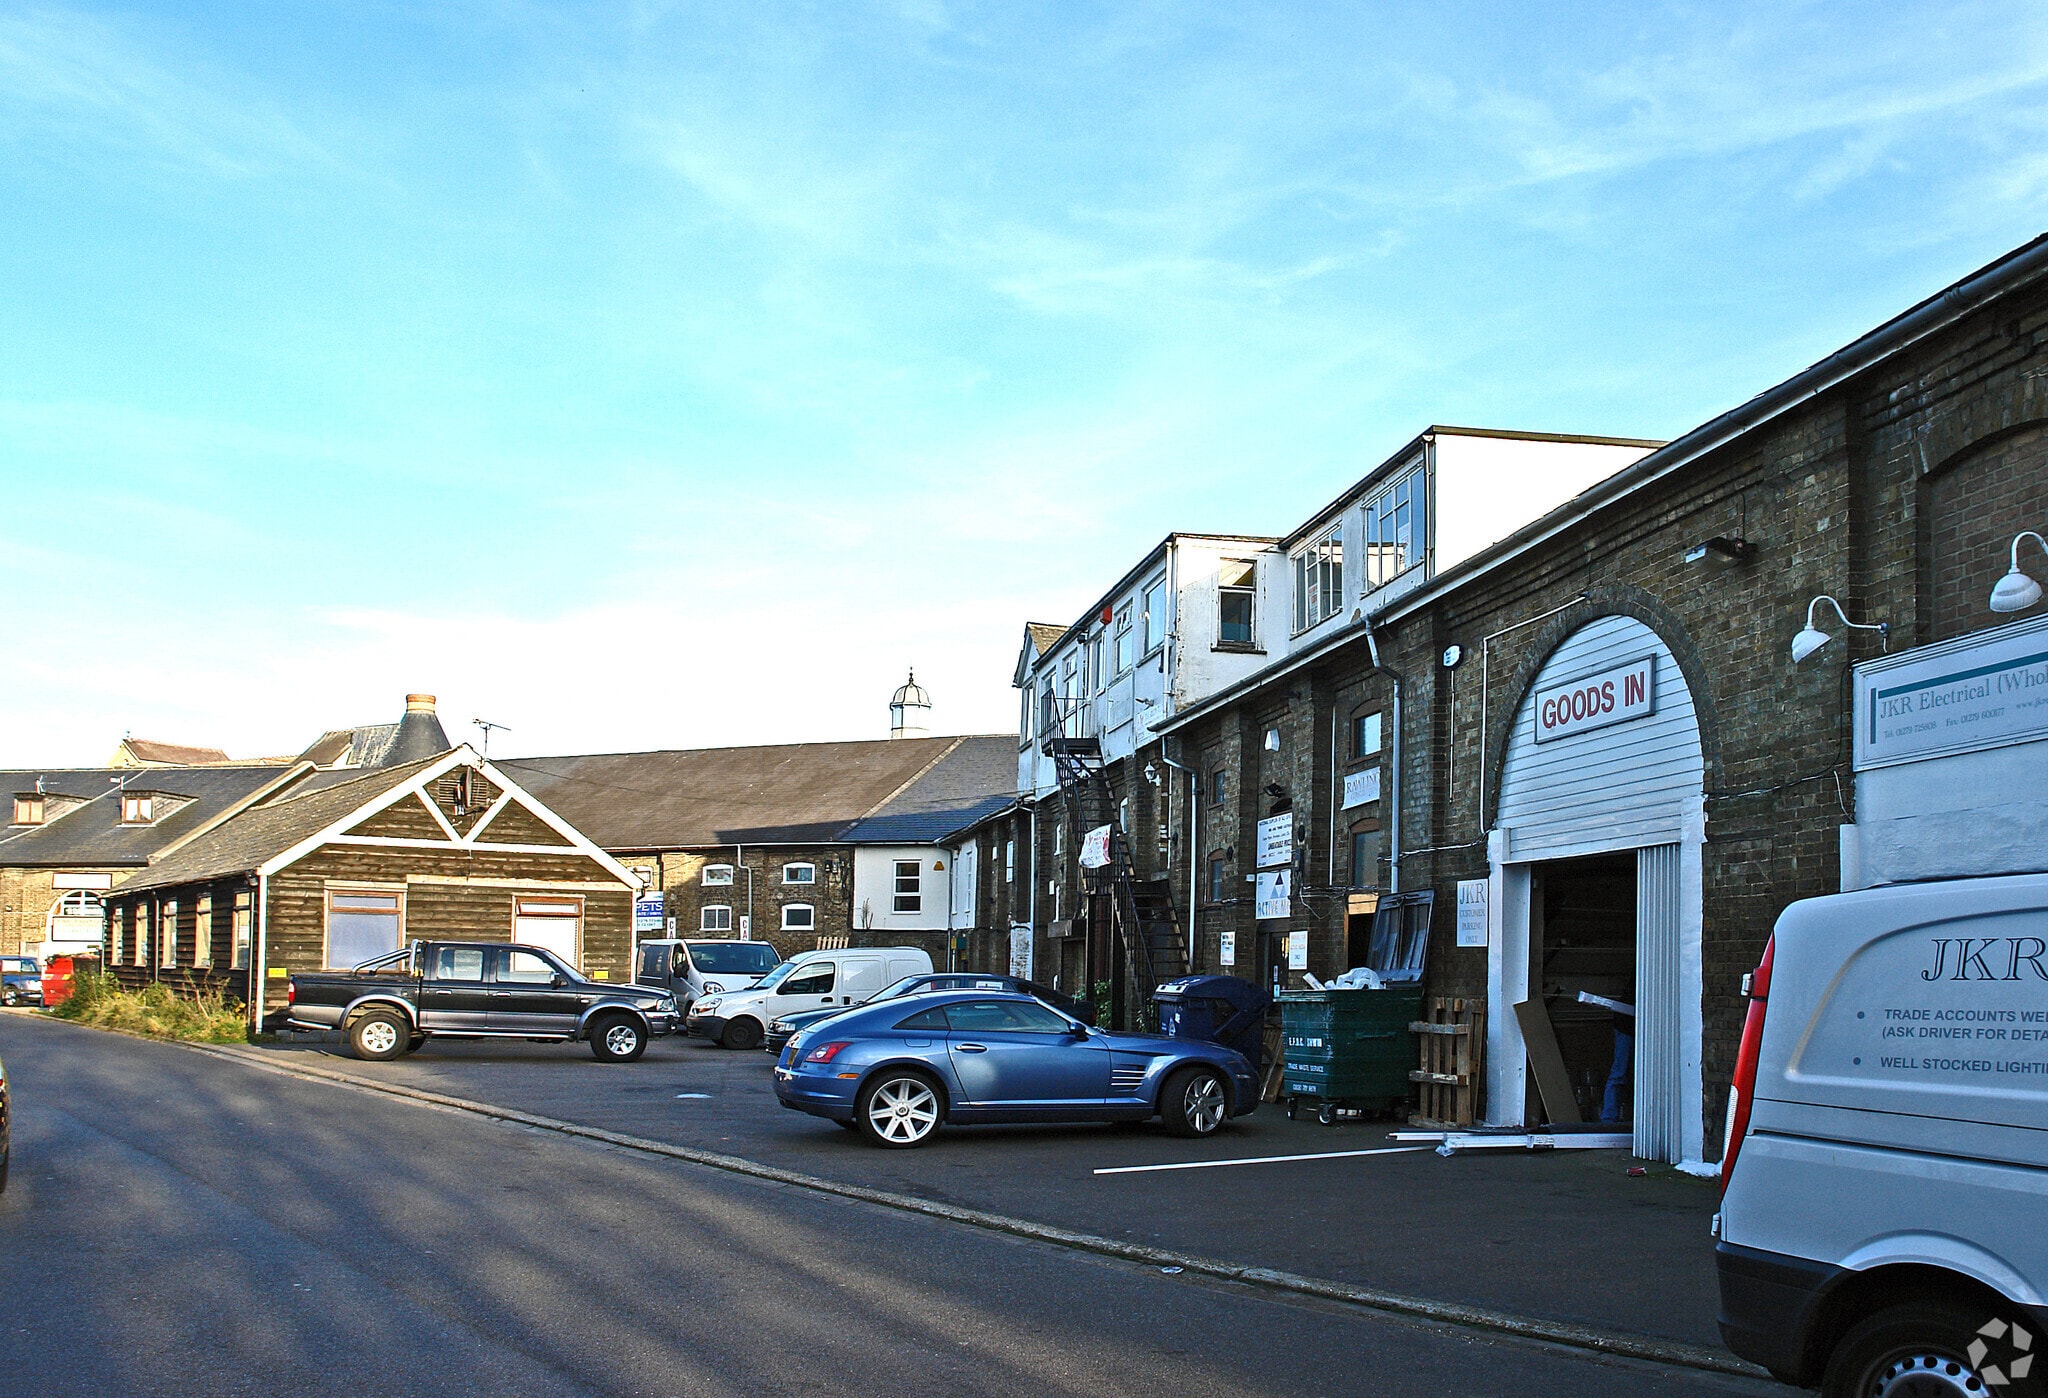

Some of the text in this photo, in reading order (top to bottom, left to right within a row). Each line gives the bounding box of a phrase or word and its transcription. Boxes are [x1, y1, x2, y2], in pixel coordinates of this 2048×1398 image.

[1542, 671, 1645, 729] GOODS IN
[1880, 696, 1913, 719] JKR
[1919, 678, 1990, 711] Electrical
[1961, 712, 1980, 723] 01279
[1459, 882, 1486, 905] JKR
[1462, 921, 1483, 931] PARKING
[1920, 937, 2048, 982] JKR
[1884, 1008, 1931, 1020] TRADE
[1934, 1010, 2016, 1022] ACCOUNTS
[1882, 1026, 1915, 1039] (ASK
[1919, 1027, 1972, 1039] DRIVER
[1976, 1028, 2007, 1040] FOR
[1880, 1057, 2048, 1074] WELL STOCKED LIGHTI
